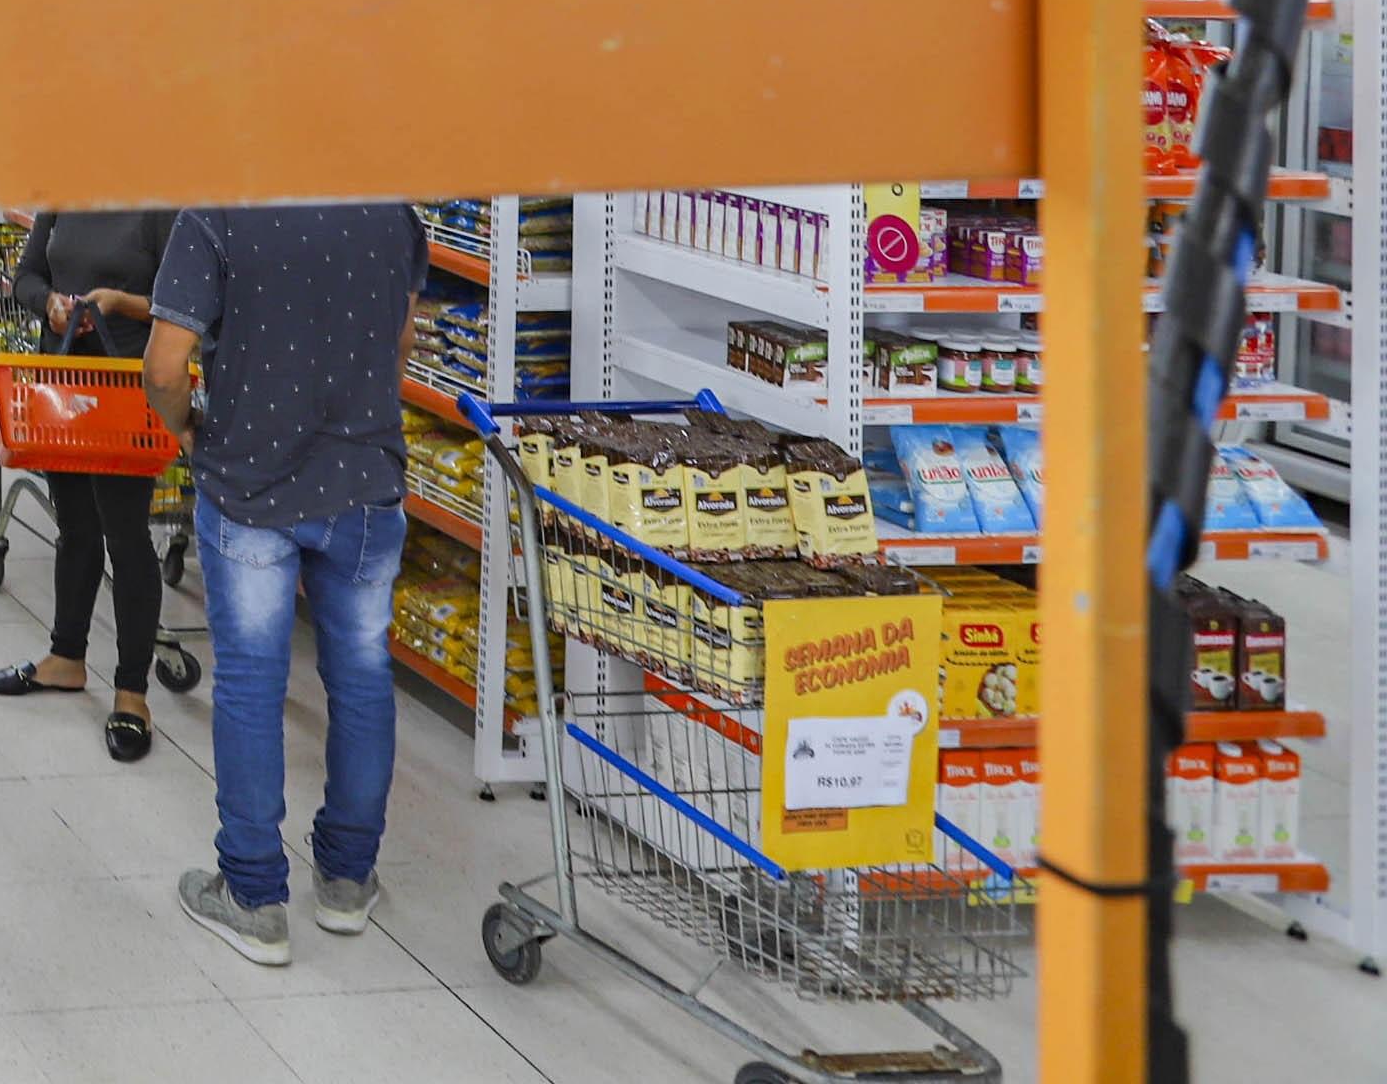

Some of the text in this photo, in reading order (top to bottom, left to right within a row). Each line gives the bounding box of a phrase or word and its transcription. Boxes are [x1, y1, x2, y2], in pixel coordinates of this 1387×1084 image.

[783, 618, 914, 673] SEMANA DA
[794, 647, 912, 696] ECONOMIA
